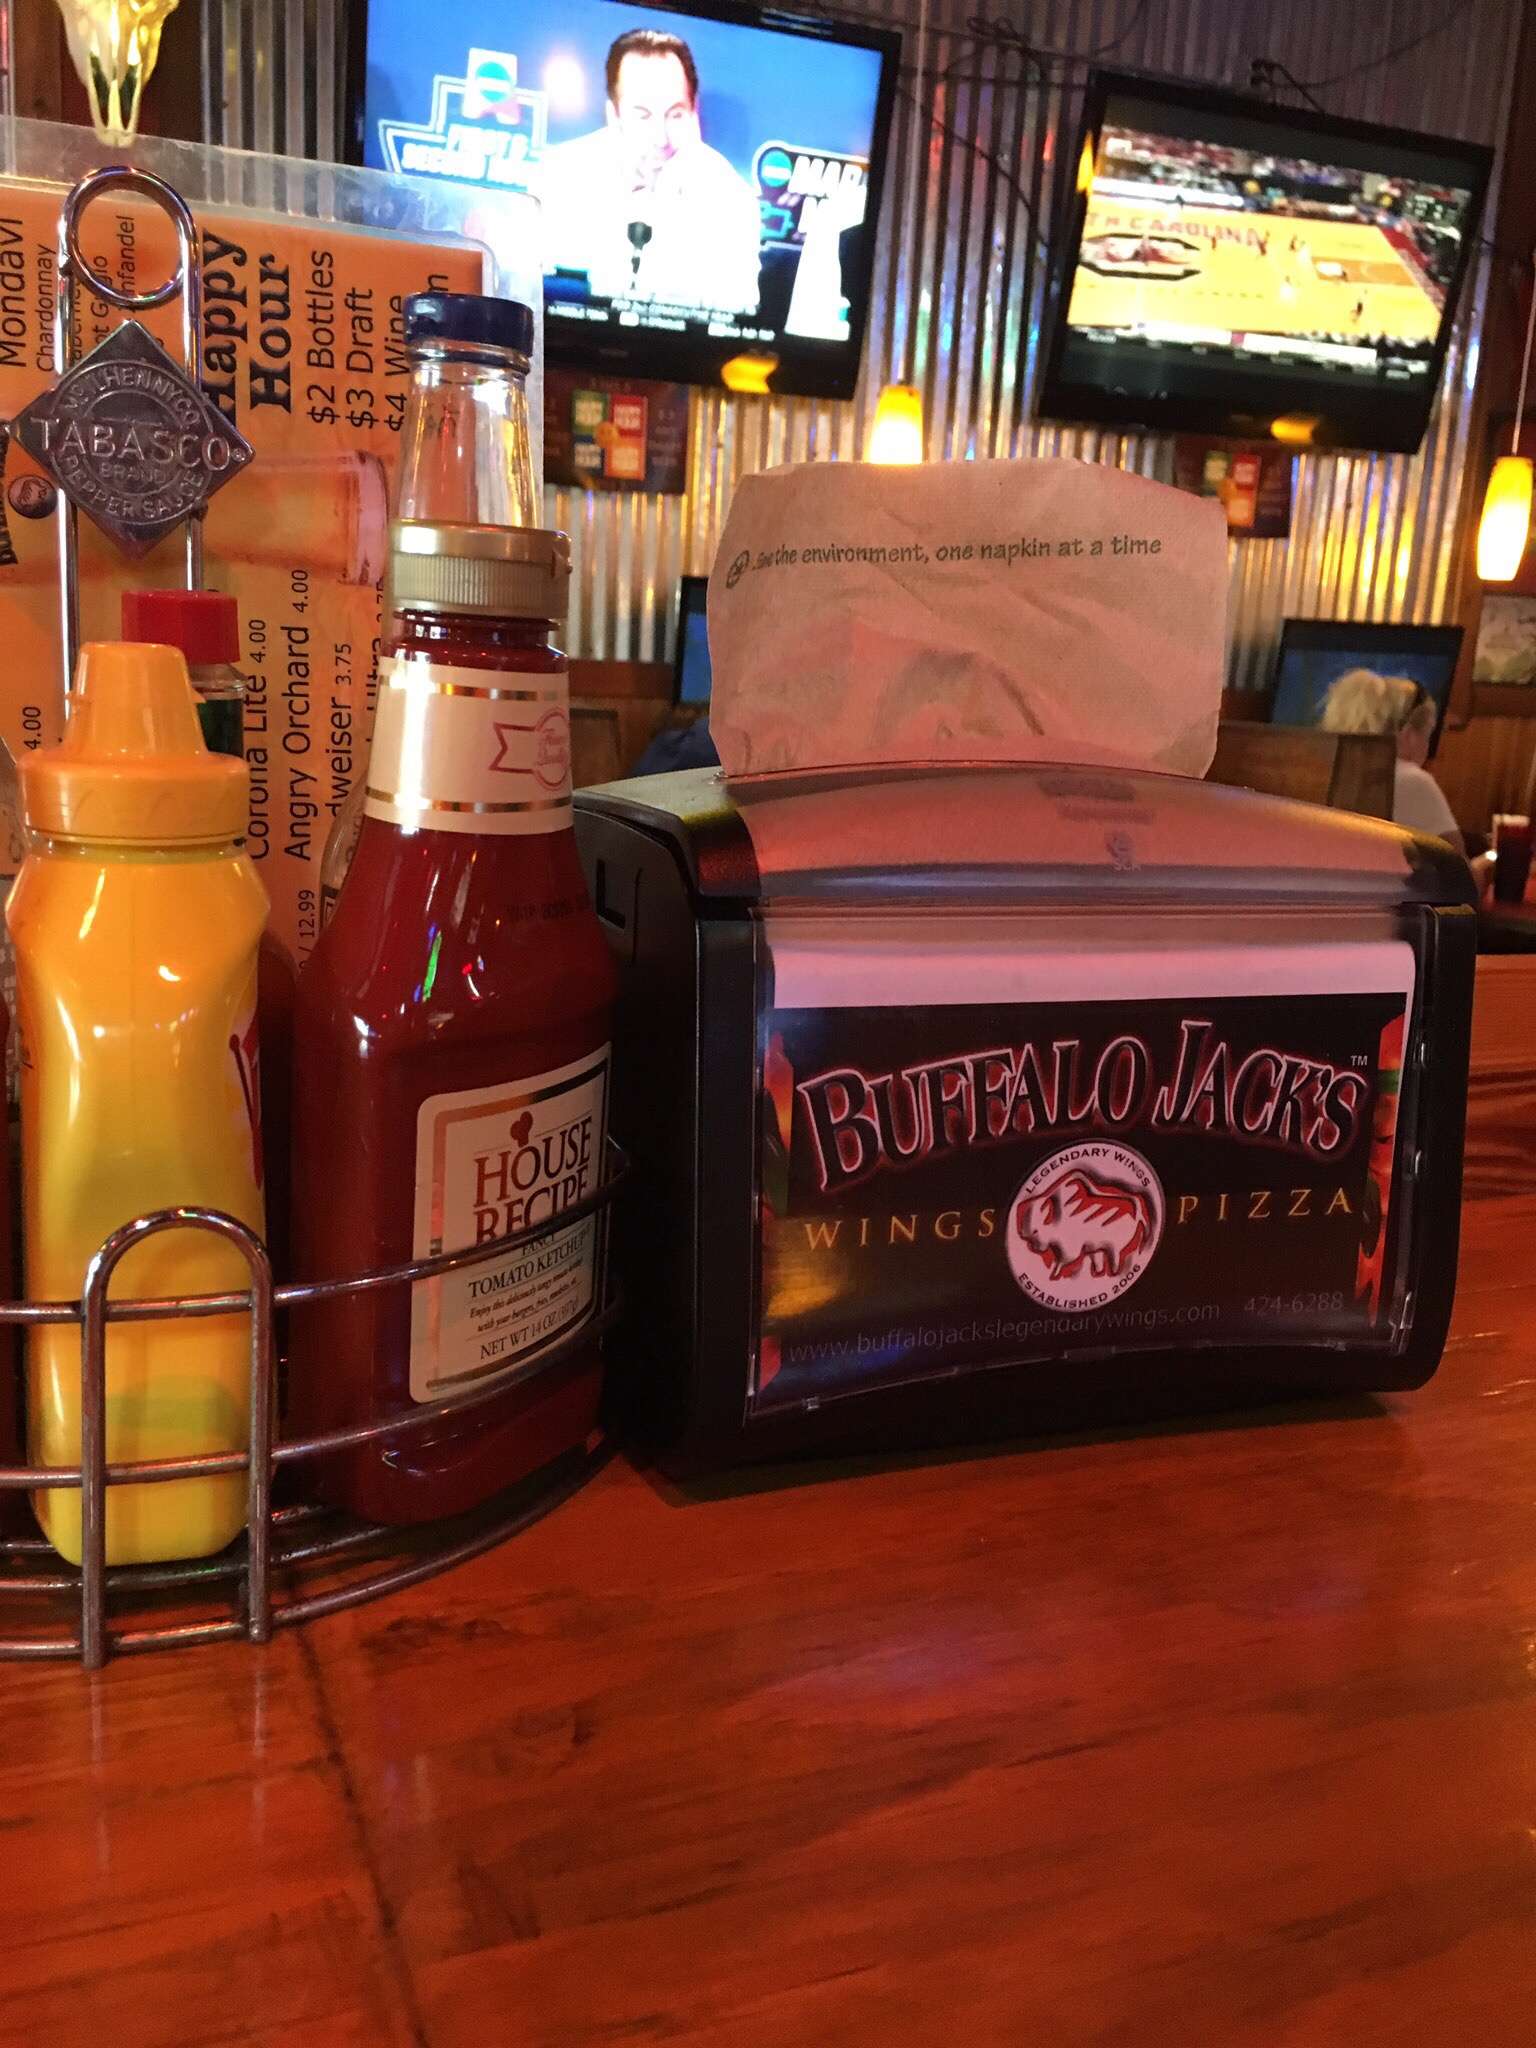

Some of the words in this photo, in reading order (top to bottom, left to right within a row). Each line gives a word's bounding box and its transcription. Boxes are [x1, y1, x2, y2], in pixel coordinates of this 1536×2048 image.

[0, 217, 27, 368] Mondavi
[35, 243, 57, 372] Chardonnay
[304, 249, 336, 369] Bottles
[249, 253, 292, 414] Hour
[344, 286, 374, 374] Draft
[384, 294, 411, 378] Wine
[306, 383, 341, 425] $2
[345, 387, 379, 430] $3
[383, 392, 409, 432] $4
[30, 417, 231, 472] TABASCO
[775, 543, 797, 566] the
[801, 543, 930, 565] environment,
[935, 544, 973, 562] one
[980, 537, 1051, 567] napkin
[1057, 537, 1085, 557] at
[1090, 539, 1104, 556] a
[1110, 534, 1162, 555] time
[291, 568, 309, 614] 4.00
[248, 618, 267, 664] 4.00
[334, 643, 352, 686] 3.75
[243, 674, 268, 732] Lite
[279, 625, 311, 755] Orchard
[22, 706, 42, 750] 4.00
[247, 747, 270, 860] Corona
[284, 767, 319, 862] Angry
[298, 889, 316, 938] 12.99
[796, 1034, 1149, 1193] BUFFALO
[1152, 1018, 1371, 1163] JACK'S
[472, 1114, 593, 1209] HOUSE
[1025, 1147, 1111, 1195] LEGENDARY
[1113, 1150, 1151, 1188] WINGS
[472, 1164, 589, 1247] RECIPE
[804, 1208, 998, 1252] WINGS
[1177, 1187, 1354, 1225] PIZZA
[467, 1262, 536, 1299] TOMATO
[535, 1234, 587, 1275] KETCHUP
[1018, 1272, 1109, 1309] ESTABLISHED
[1111, 1263, 1142, 1295] 2006
[479, 1336, 508, 1361] NET
[509, 1326, 531, 1348] WT
[788, 1301, 1221, 1363] www.buffalojackslegendarywings.com
[1243, 1290, 1345, 1319] 424-6288
